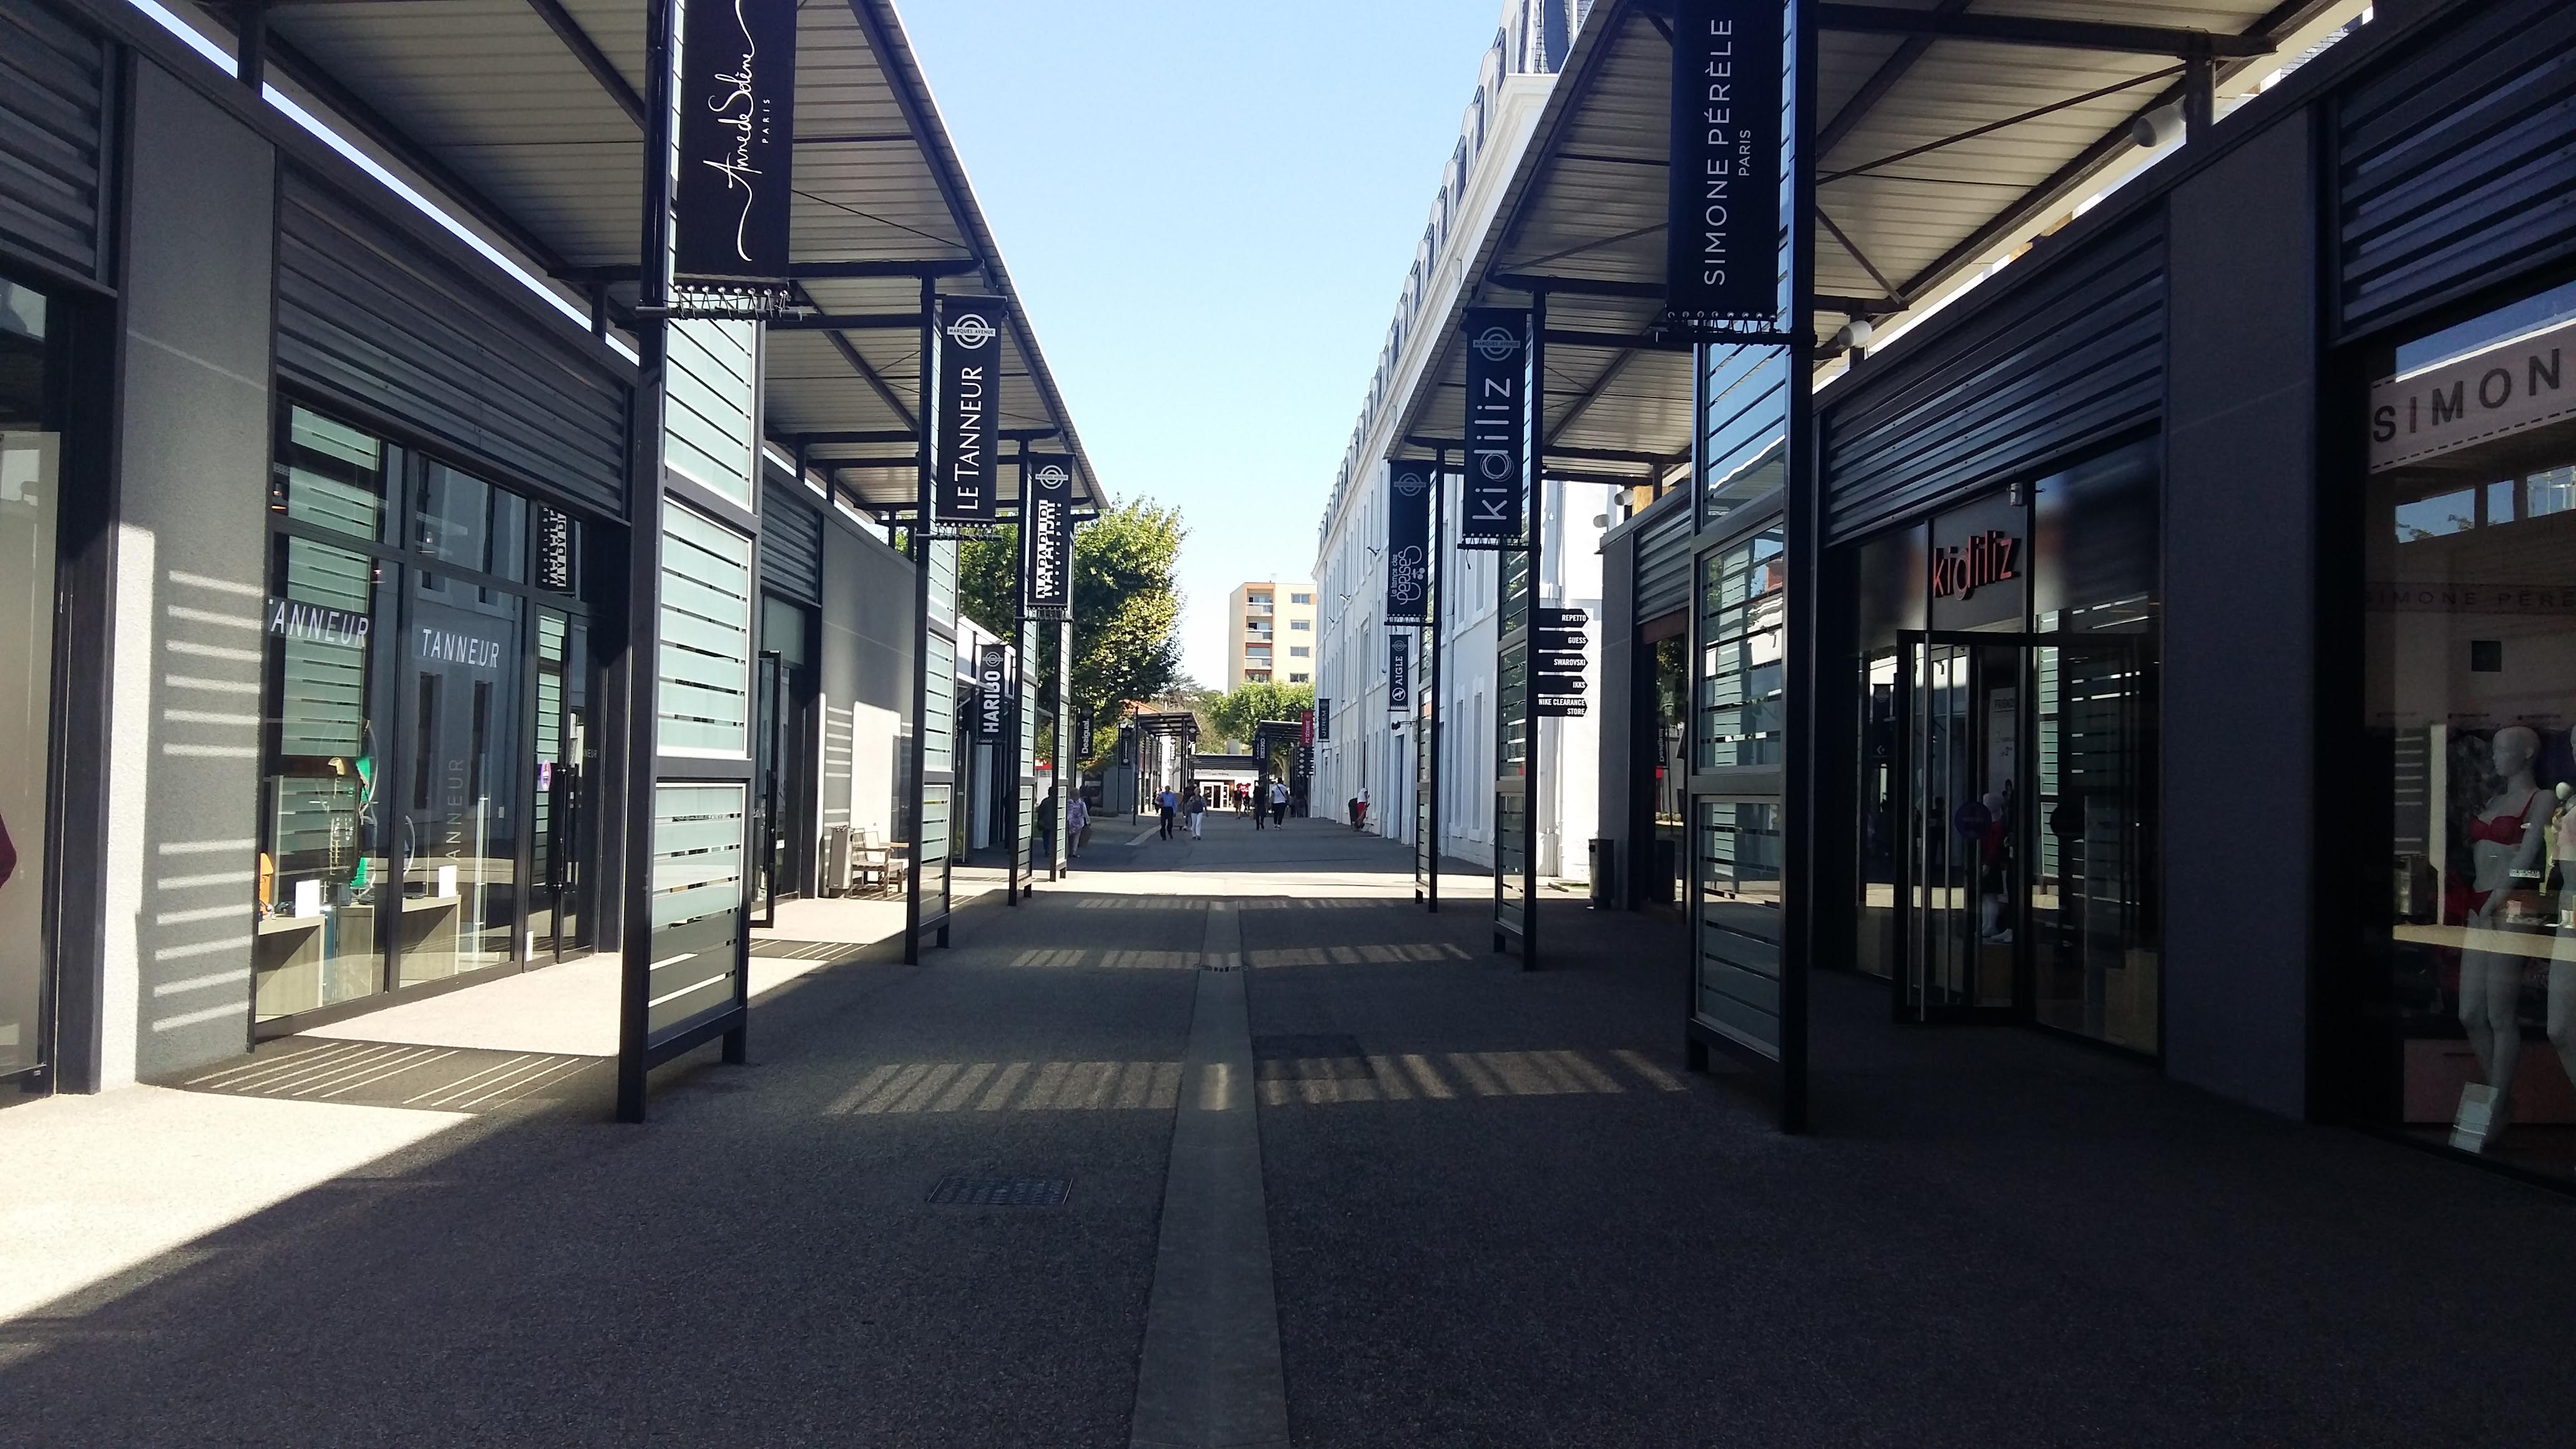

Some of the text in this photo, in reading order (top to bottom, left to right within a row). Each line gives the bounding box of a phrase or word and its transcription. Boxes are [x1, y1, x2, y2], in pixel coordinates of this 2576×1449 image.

[761, 99, 771, 144] PARIS
[1703, 19, 1733, 286] SIMONE PÉRÈLE
[1738, 129, 1751, 176] PARIS
[2373, 348, 2560, 443] SIMON
[954, 366, 983, 510] LE TANNEUR
[1471, 378, 1515, 520] kidiliz
[1036, 500, 1056, 598] NAPAPIJRI
[1053, 502, 1063, 596] geographic
[1390, 568, 1399, 588] temps
[1933, 530, 2012, 600] kidiliz
[269, 599, 369, 647] ANNEUR
[422, 628, 500, 668] TANNEUR
[983, 671, 1000, 733] HARIBO
[1395, 656, 1403, 686] AIGLE
[1553, 698, 1585, 706] CLEARANCE
[445, 759, 464, 862] ANNEUR
